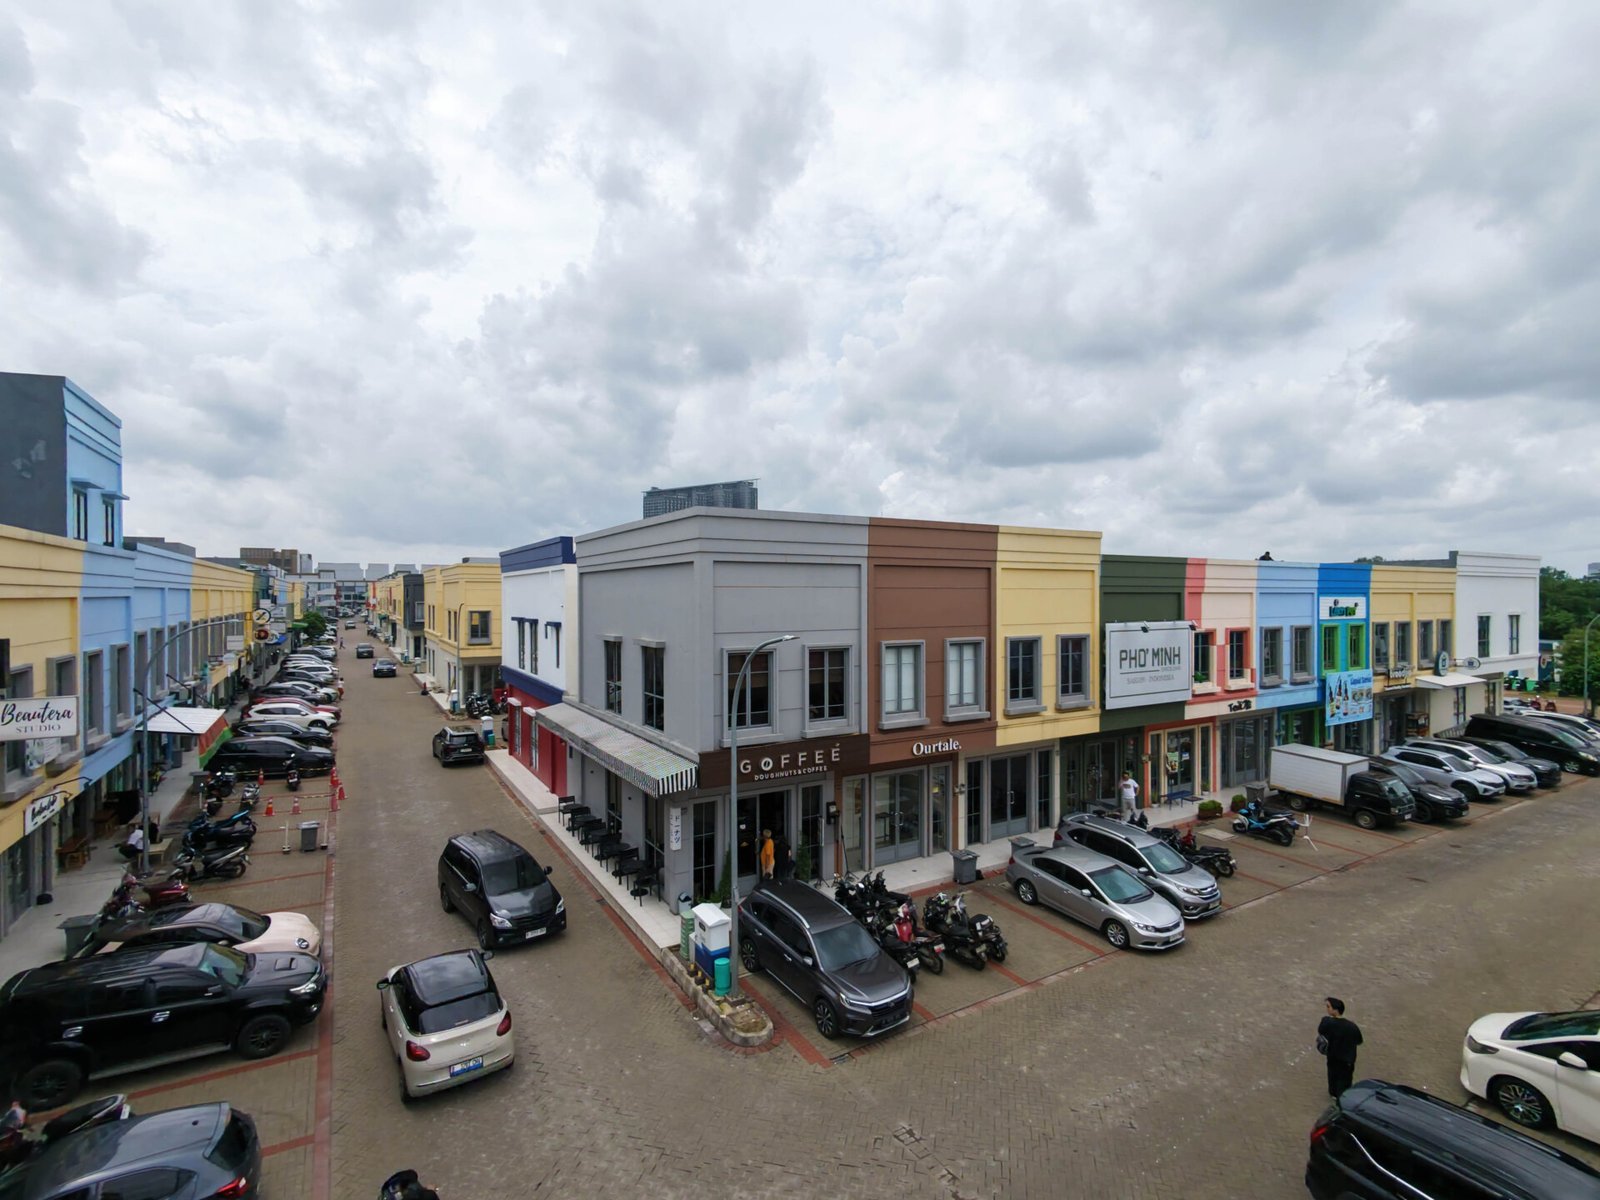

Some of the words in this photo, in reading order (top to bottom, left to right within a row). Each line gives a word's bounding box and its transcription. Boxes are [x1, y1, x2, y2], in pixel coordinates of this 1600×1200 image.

[1151, 646, 1181, 667] MINH
[1, 701, 73, 726] Beautera
[16, 724, 61, 734] STUDIO
[912, 738, 962, 756] Ourtale.
